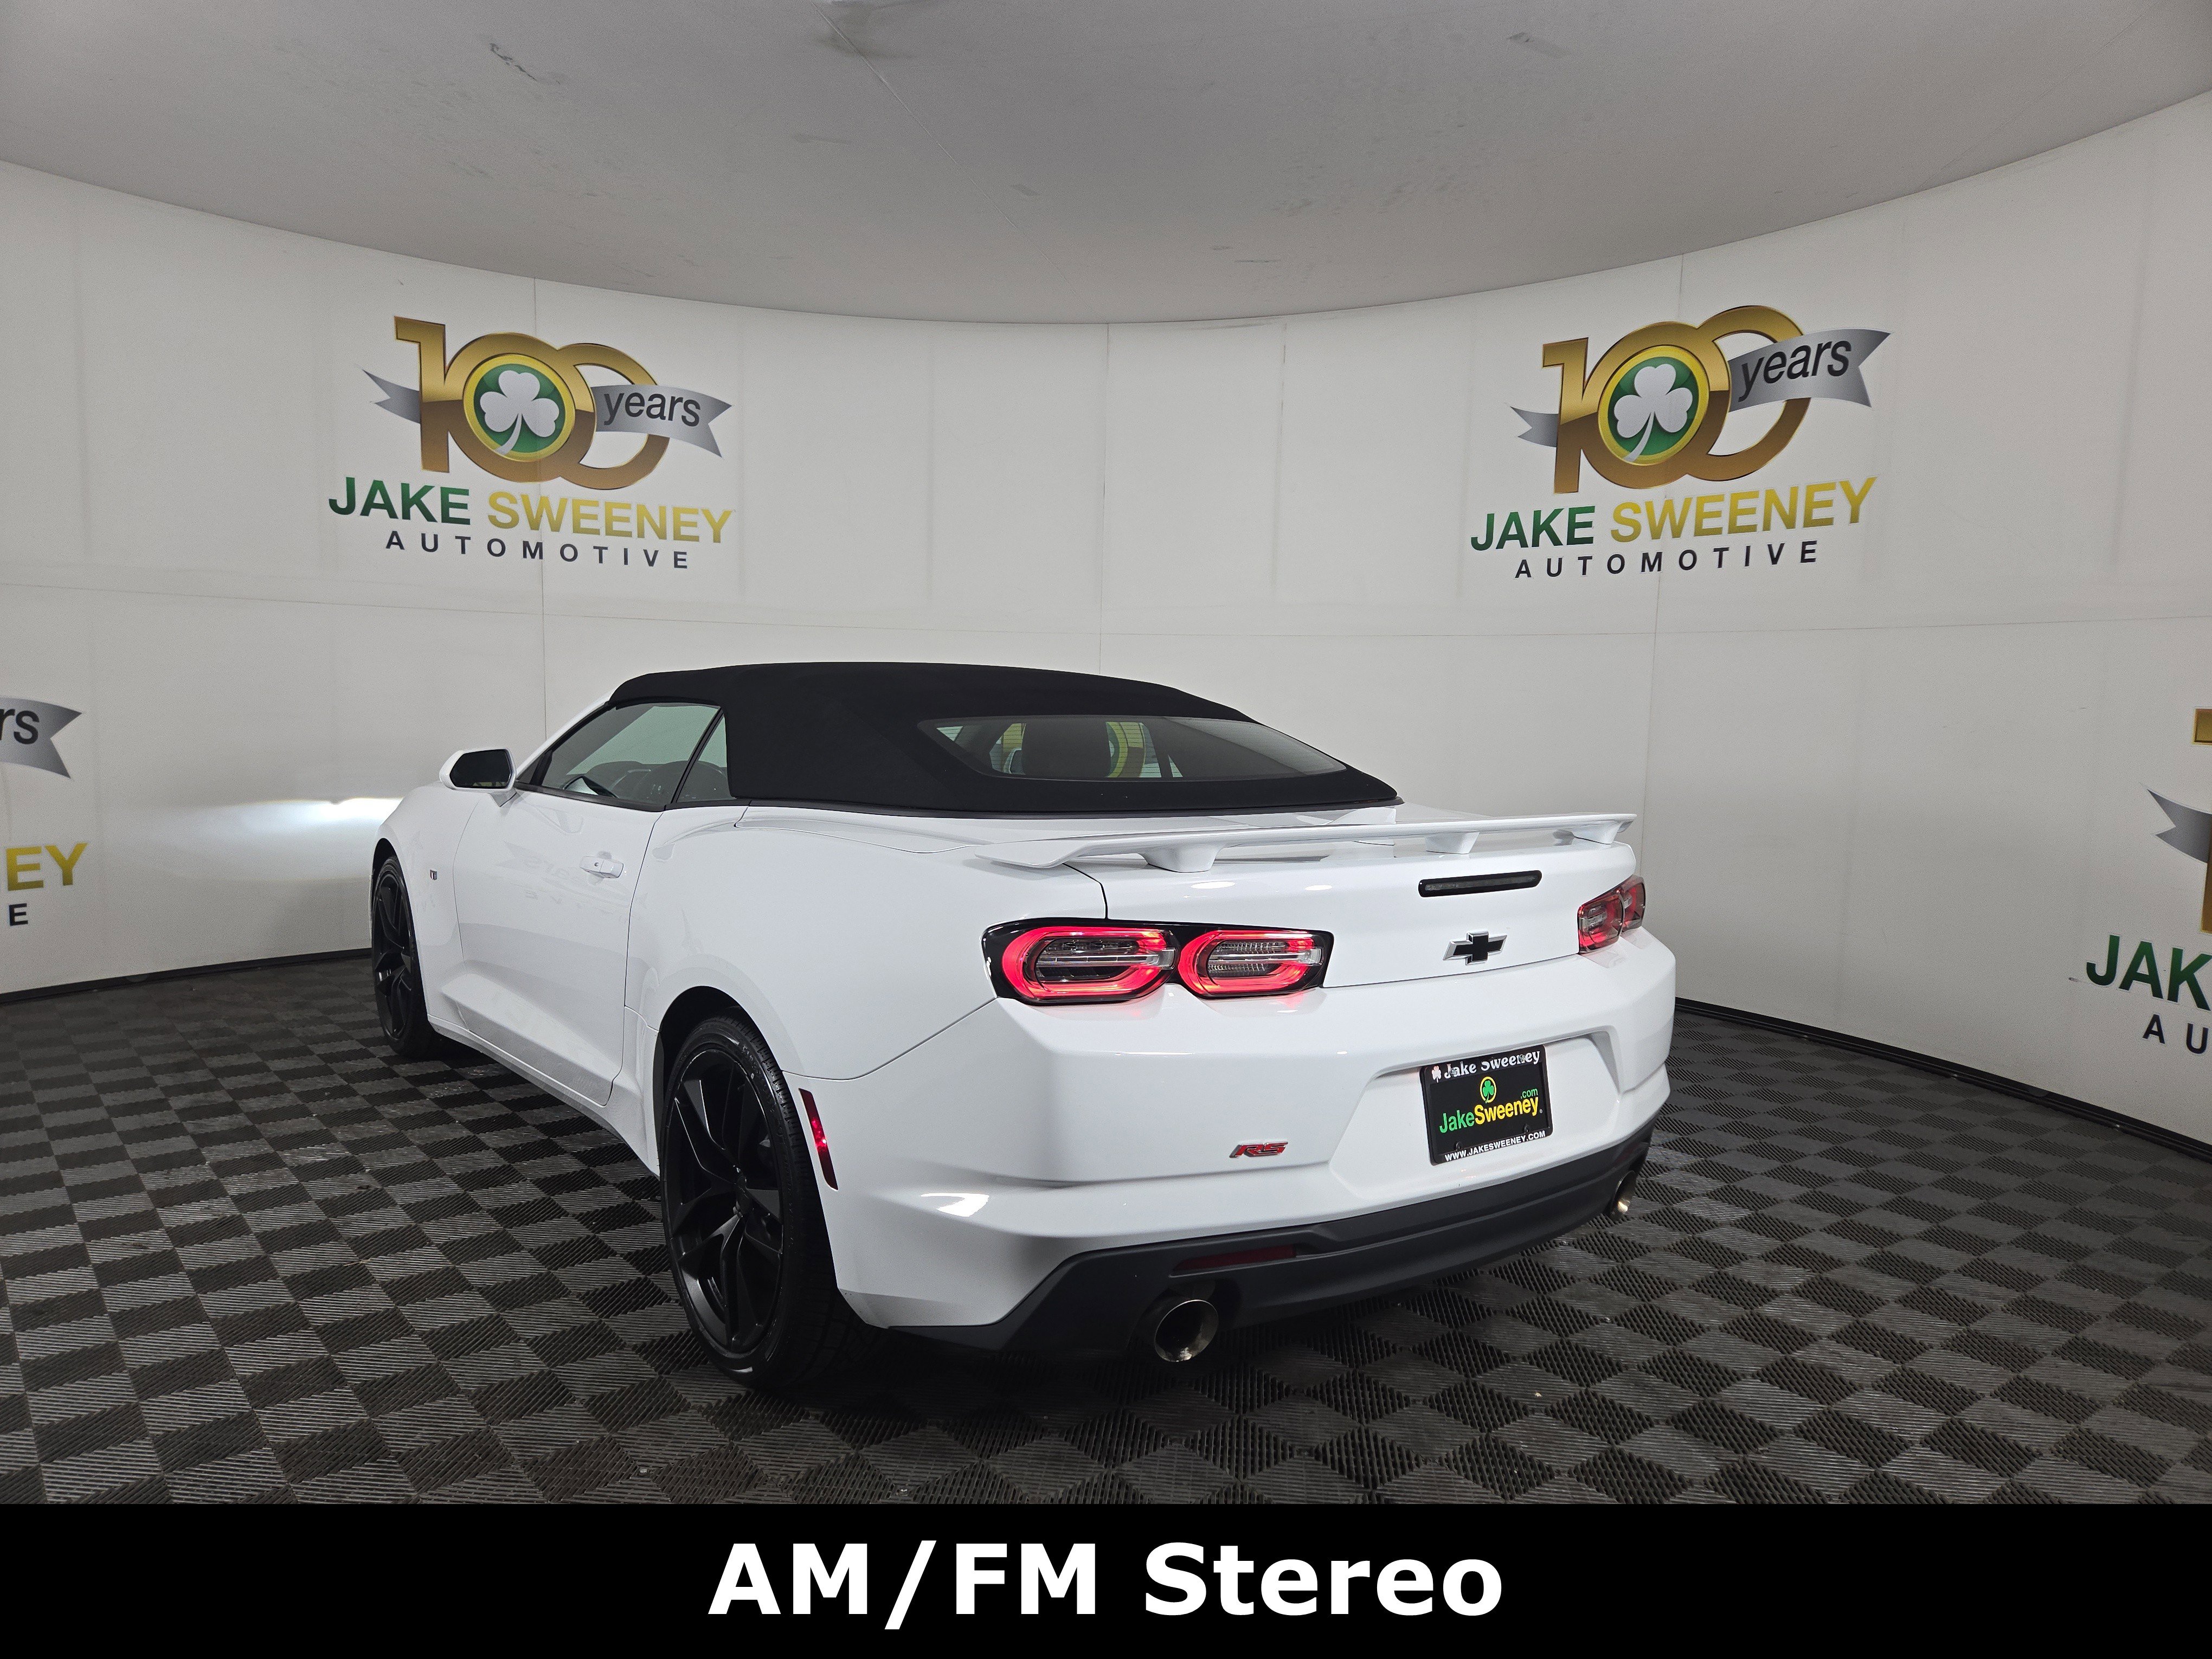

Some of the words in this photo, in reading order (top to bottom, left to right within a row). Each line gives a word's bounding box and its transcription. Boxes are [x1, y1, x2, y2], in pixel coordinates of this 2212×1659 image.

[1738, 339, 1852, 402] years
[603, 391, 701, 427] years
[329, 477, 471, 525] JAKE
[487, 491, 734, 543] SWEENEY
[1471, 505, 1596, 551] JAKE
[1610, 476, 1877, 543] SWEENEY
[385, 530, 689, 569] AUTOMOTIVE
[1515, 541, 1818, 578] AUTOMOTIVE
[1229, 1141, 1288, 1158] RS
[1445, 1130, 1545, 1161] WWW.JAKESWEENEY.COM
